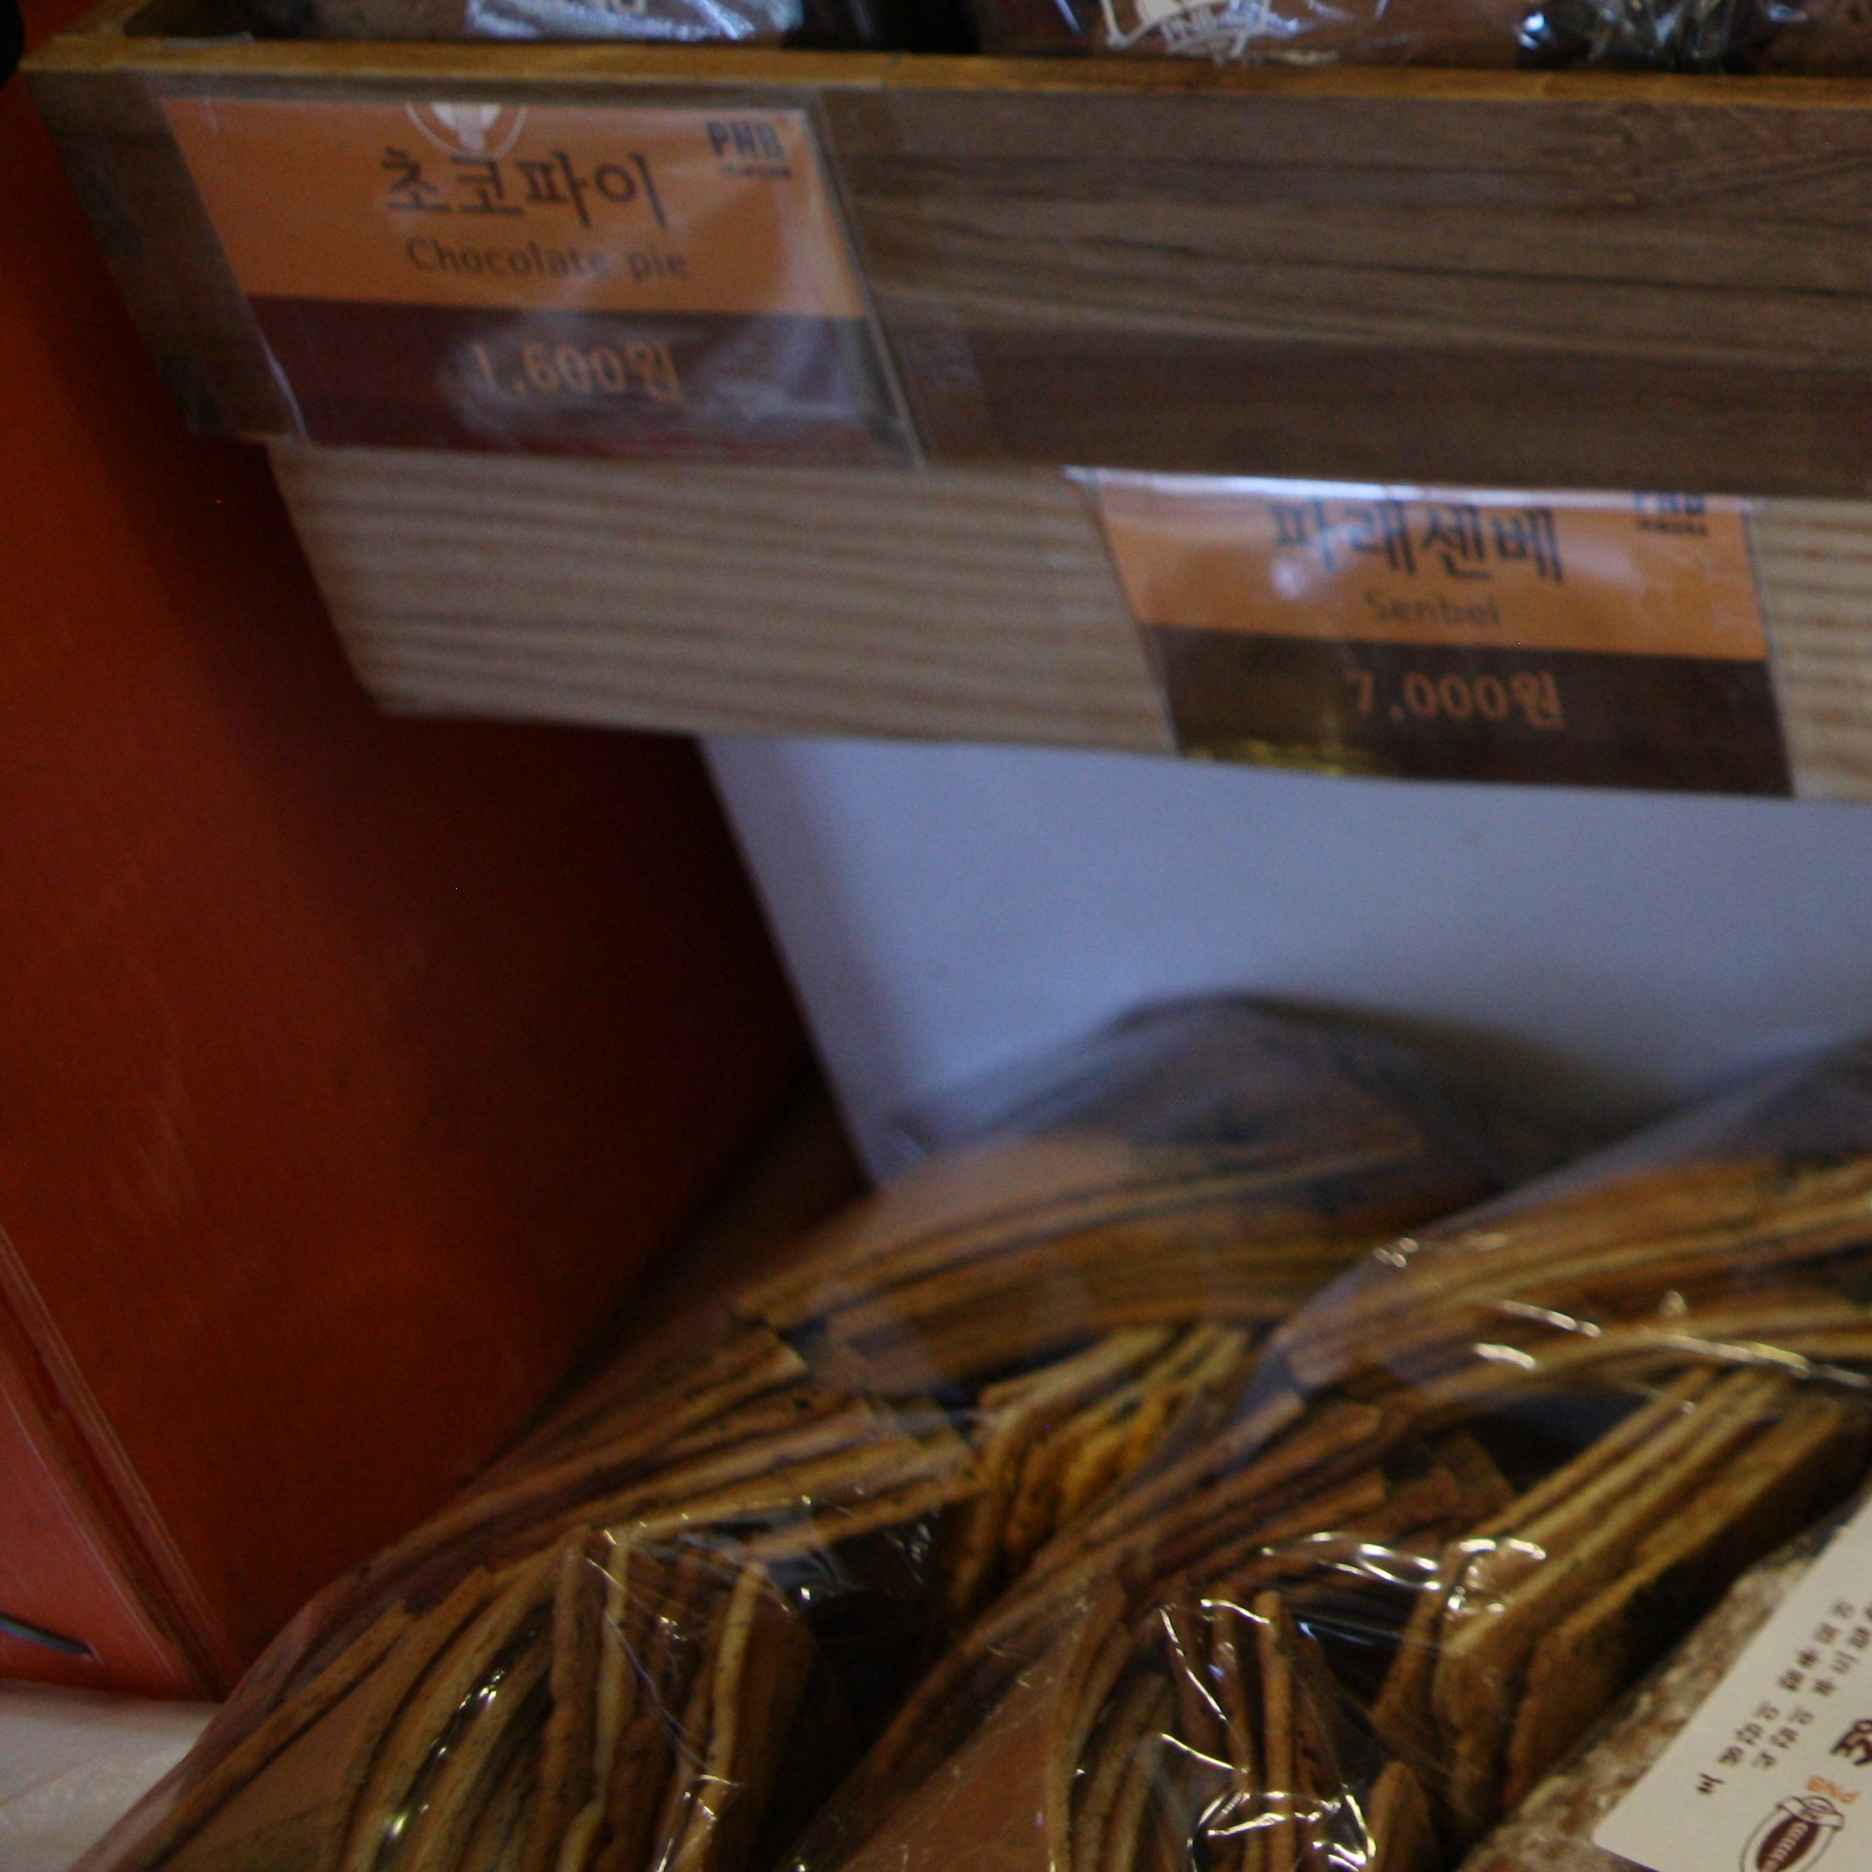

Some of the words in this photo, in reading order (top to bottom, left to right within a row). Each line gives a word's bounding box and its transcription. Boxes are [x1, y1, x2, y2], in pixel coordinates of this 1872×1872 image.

[381, 148, 668, 228] 초코파이
[407, 237, 605, 281] Chocolate
[631, 244, 687, 281] pie
